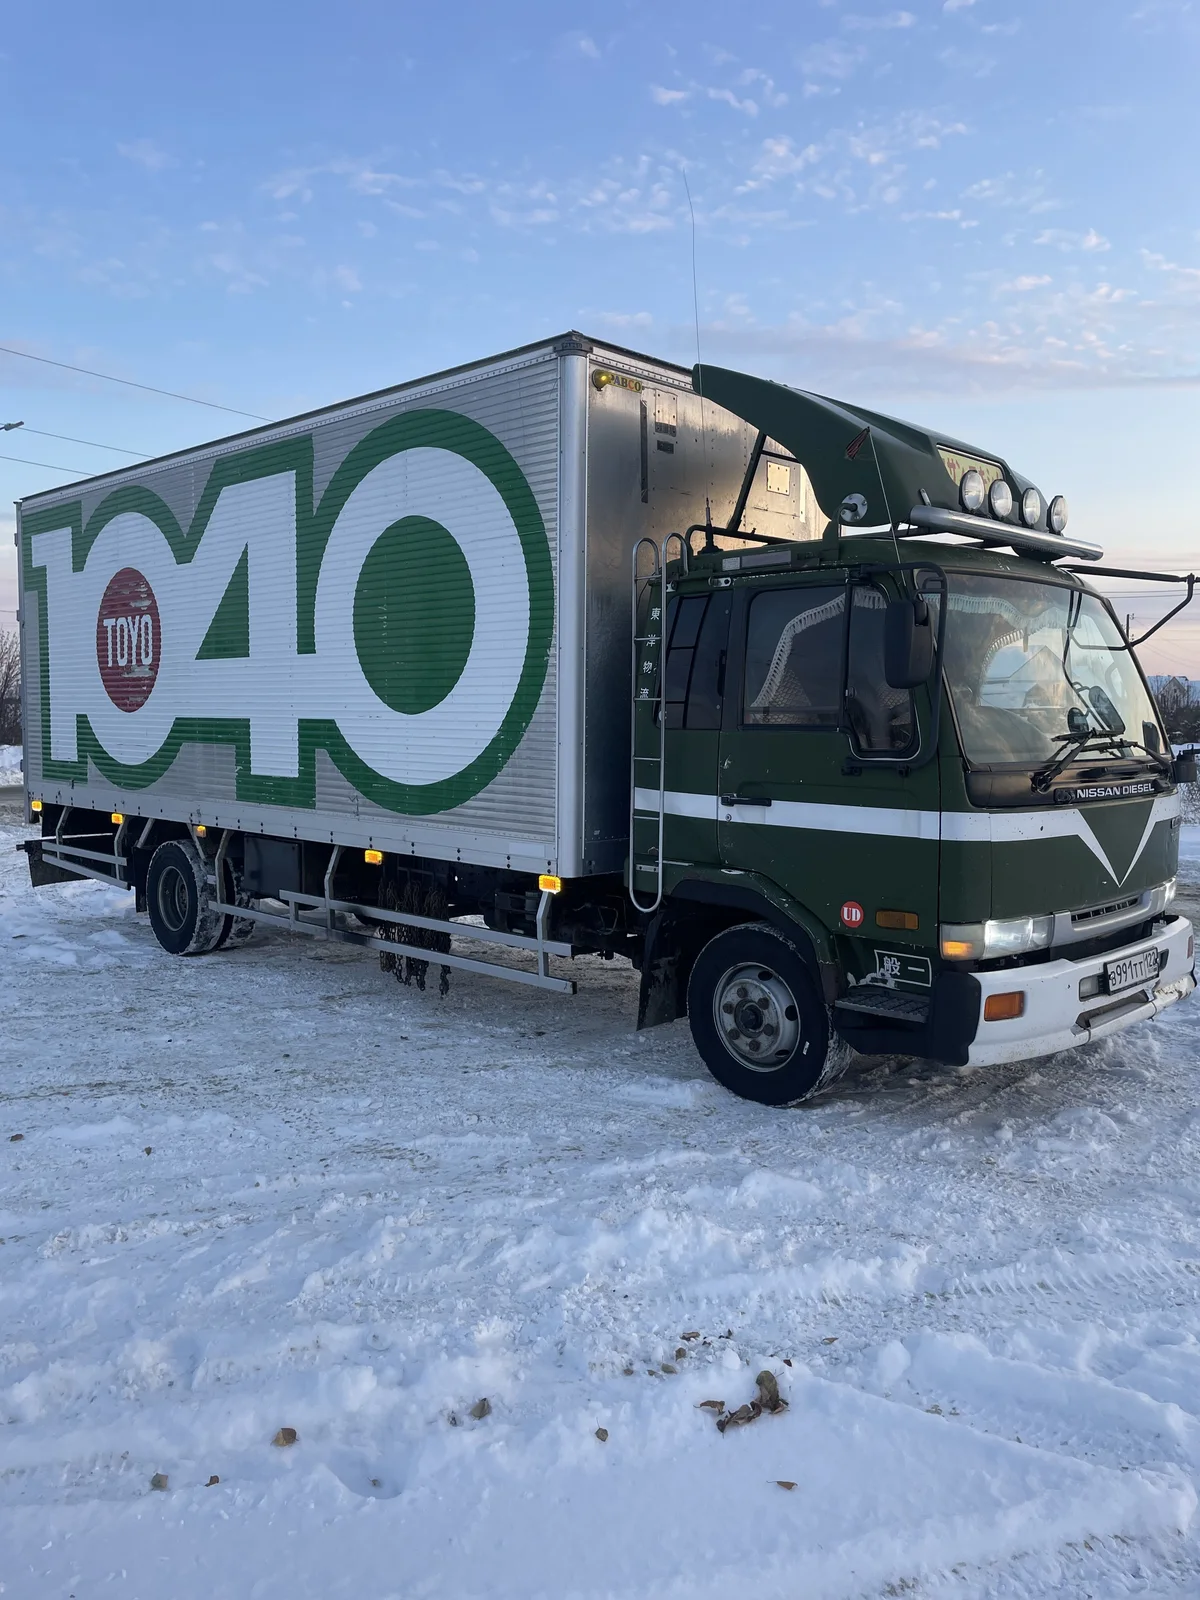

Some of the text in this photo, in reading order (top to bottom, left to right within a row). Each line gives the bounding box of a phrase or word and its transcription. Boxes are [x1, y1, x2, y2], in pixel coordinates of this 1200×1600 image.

[31, 446, 530, 786] 1040
[103, 614, 153, 668] TOYO
[1076, 782, 1155, 799] NISSAN DIESEL
[843, 906, 861, 922] UD
